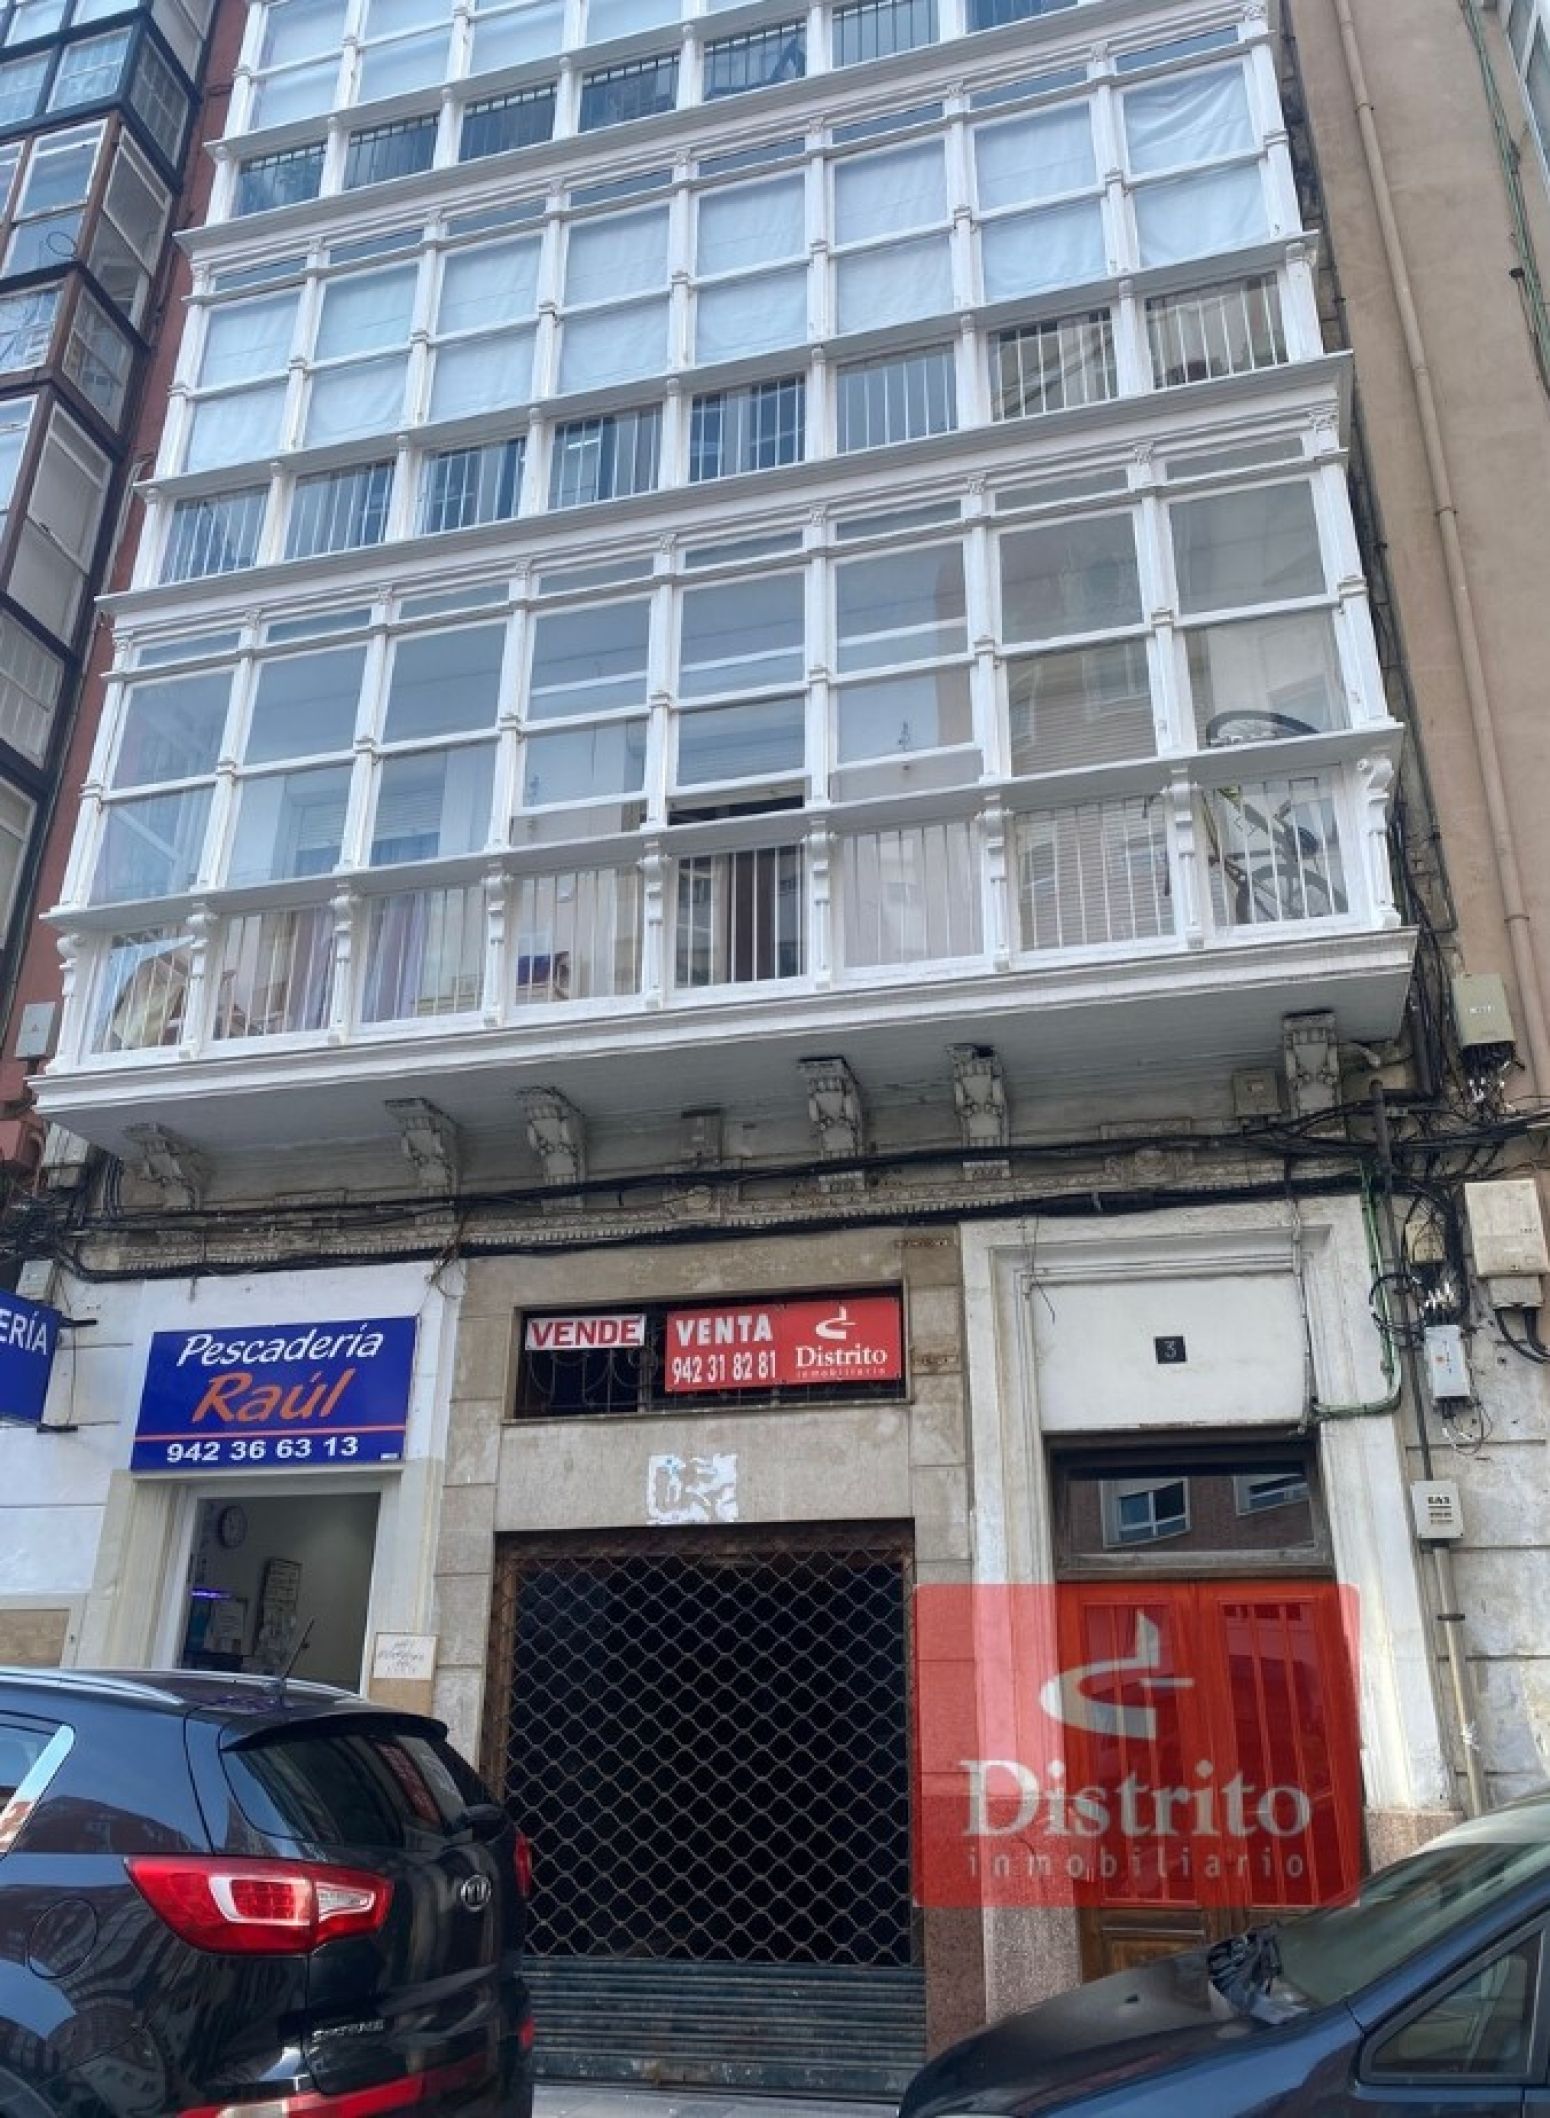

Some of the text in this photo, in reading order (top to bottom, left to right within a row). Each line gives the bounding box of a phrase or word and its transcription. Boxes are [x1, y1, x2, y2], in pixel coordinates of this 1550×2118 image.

[176, 1323, 385, 1367] Pescadería
[531, 1319, 641, 1347] VENDE
[676, 1313, 773, 1347] VENTA
[795, 1342, 888, 1368] Distrito
[1164, 1340, 1177, 1360] 3
[672, 1350, 776, 1385] 942 31 82 81
[192, 1368, 356, 1424] Raúl
[167, 1436, 359, 1463] 942 36 63 13
